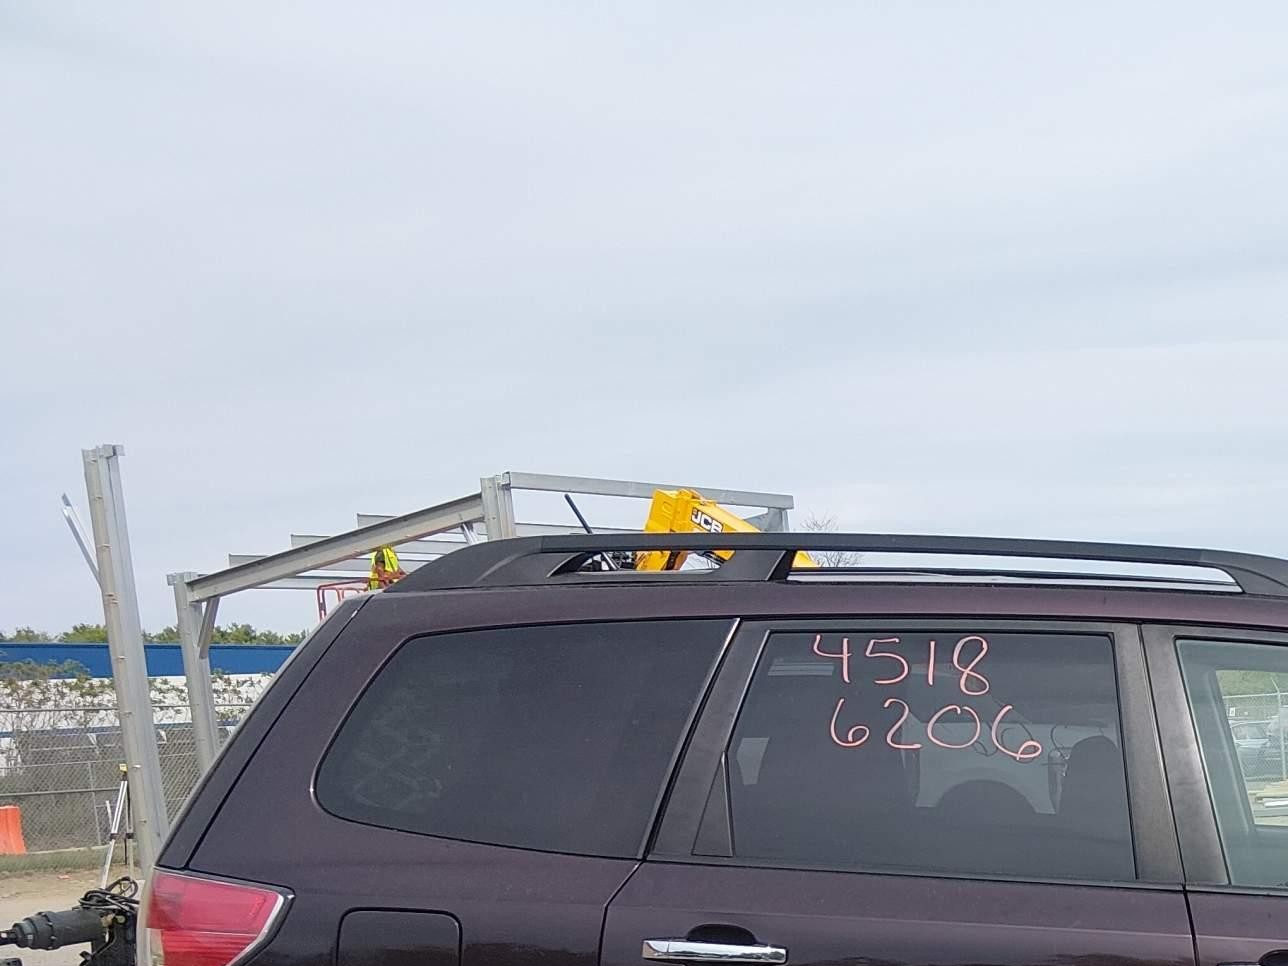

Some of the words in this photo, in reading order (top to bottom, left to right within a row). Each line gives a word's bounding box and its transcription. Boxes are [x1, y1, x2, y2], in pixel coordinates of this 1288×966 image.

[691, 508, 723, 533] JCB
[813, 634, 990, 696] 4518
[829, 698, 1043, 761] 6206
